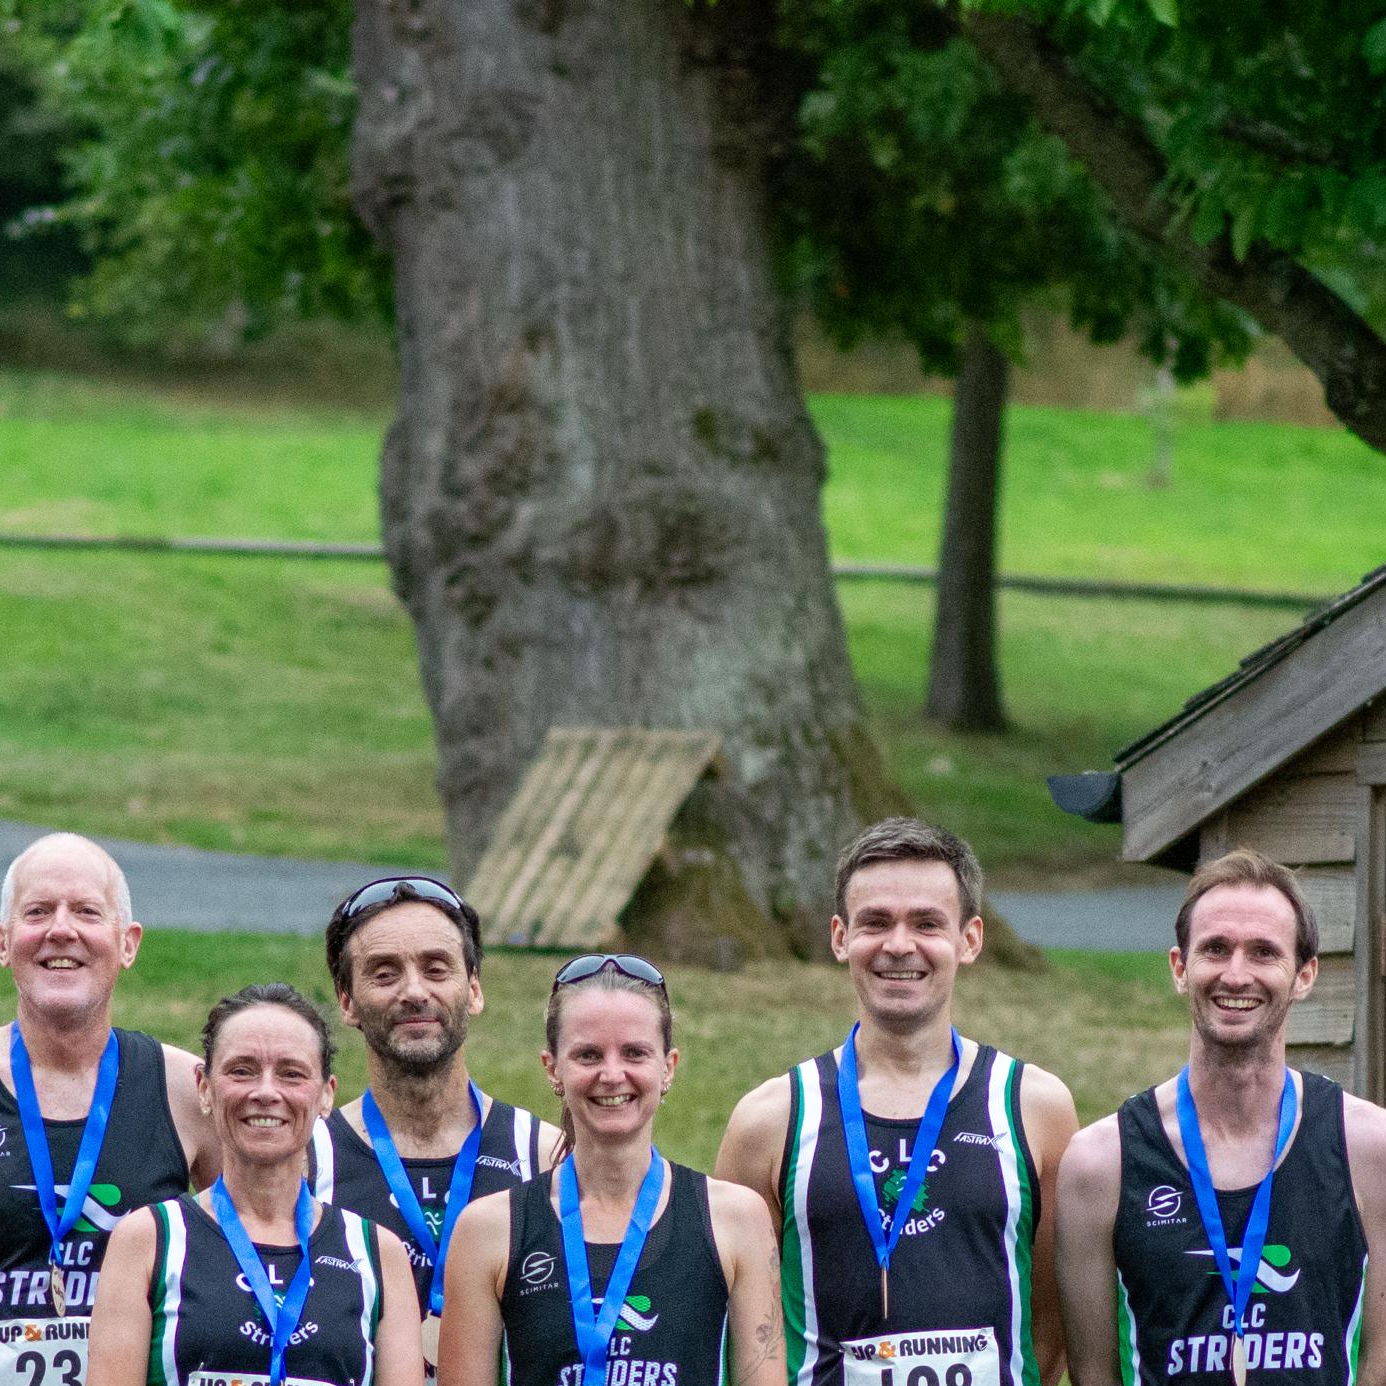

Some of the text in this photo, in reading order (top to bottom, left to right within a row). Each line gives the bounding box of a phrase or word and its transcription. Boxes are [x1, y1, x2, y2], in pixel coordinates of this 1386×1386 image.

[49, 1241, 93, 1266] LC
[236, 1264, 314, 1292] CL
[24, 1324, 42, 1342] &
[240, 1321, 318, 1347] Striers
[607, 1336, 632, 1356] LC
[851, 1334, 988, 1360] UP & RUNNING
[1167, 1332, 1324, 1376] STRDERS
